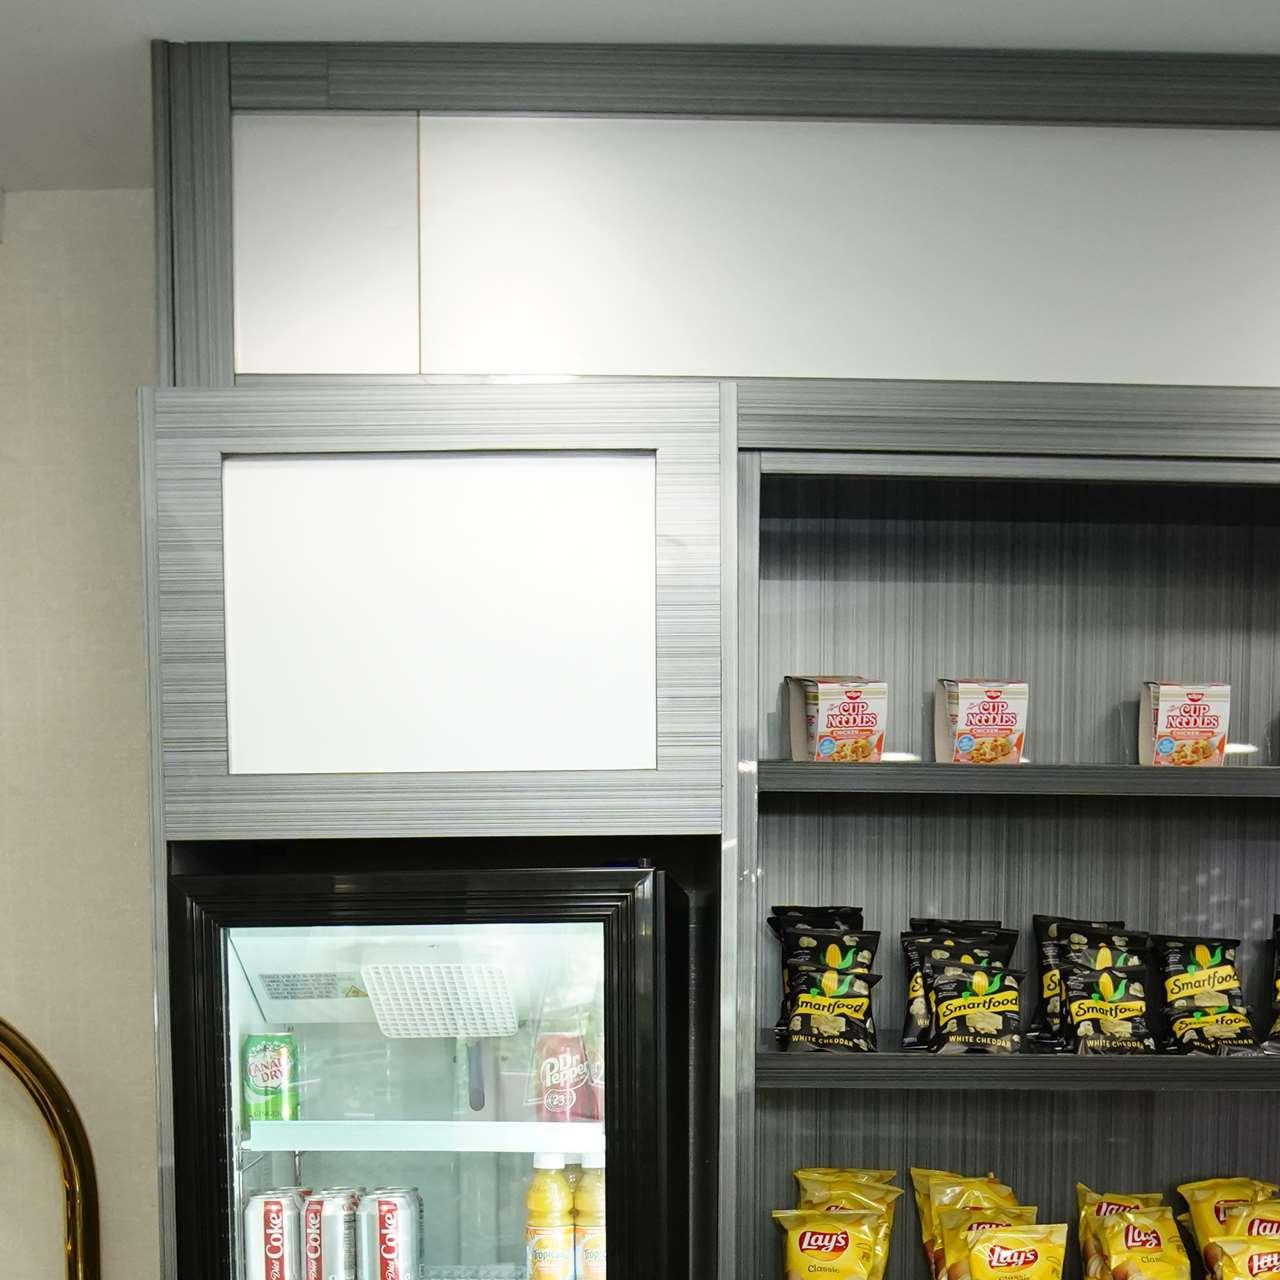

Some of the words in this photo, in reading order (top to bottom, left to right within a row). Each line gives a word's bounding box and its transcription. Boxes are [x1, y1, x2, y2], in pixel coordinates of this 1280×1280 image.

[839, 702, 868, 715] CUP
[979, 701, 1008, 713] CUP
[1181, 704, 1209, 716] CUP
[826, 713, 877, 728] NOODLES
[966, 713, 1016, 726] NOODLES
[1167, 715, 1218, 728] NOODLES
[942, 996, 1018, 1017] Smartfood
[949, 1035, 974, 1043] WHITE
[976, 1036, 1011, 1047] CHEDDAR
[265, 1211, 284, 1259] Coke
[306, 1212, 321, 1259] Coke
[380, 1211, 397, 1259] Coke
[801, 1232, 848, 1251] Lay's
